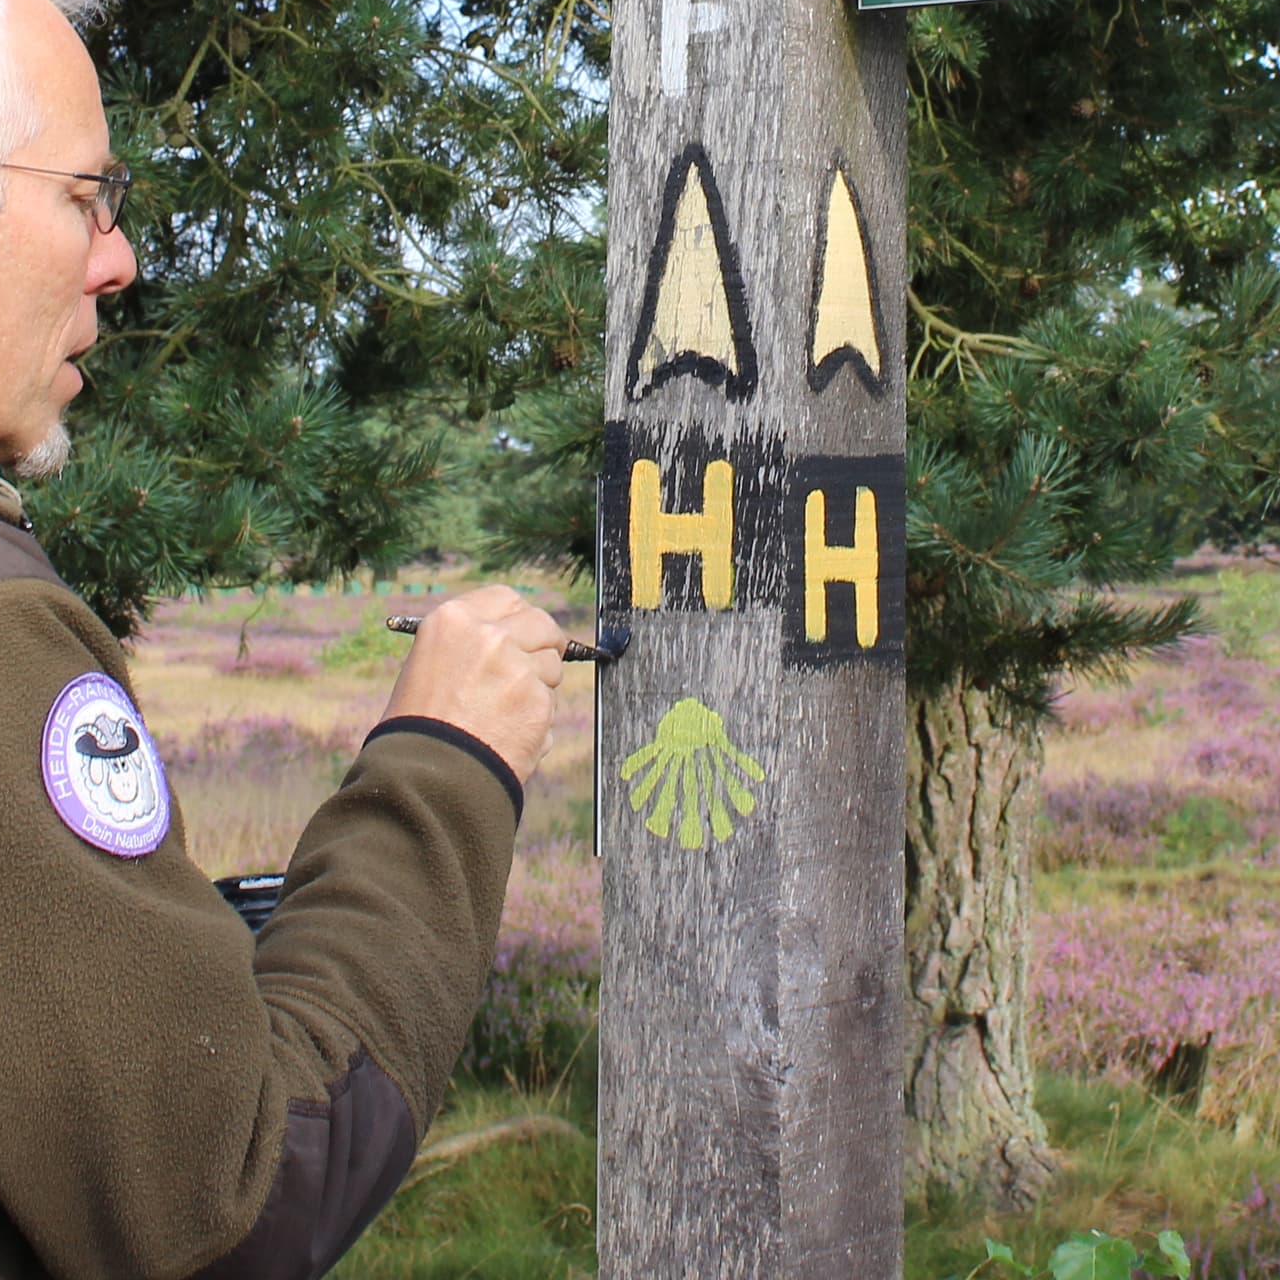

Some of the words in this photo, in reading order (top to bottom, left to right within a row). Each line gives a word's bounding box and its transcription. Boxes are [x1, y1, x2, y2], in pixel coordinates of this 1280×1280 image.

[629, 458, 734, 610] H
[805, 486, 879, 650] H
[82, 813, 114, 845] Dein
